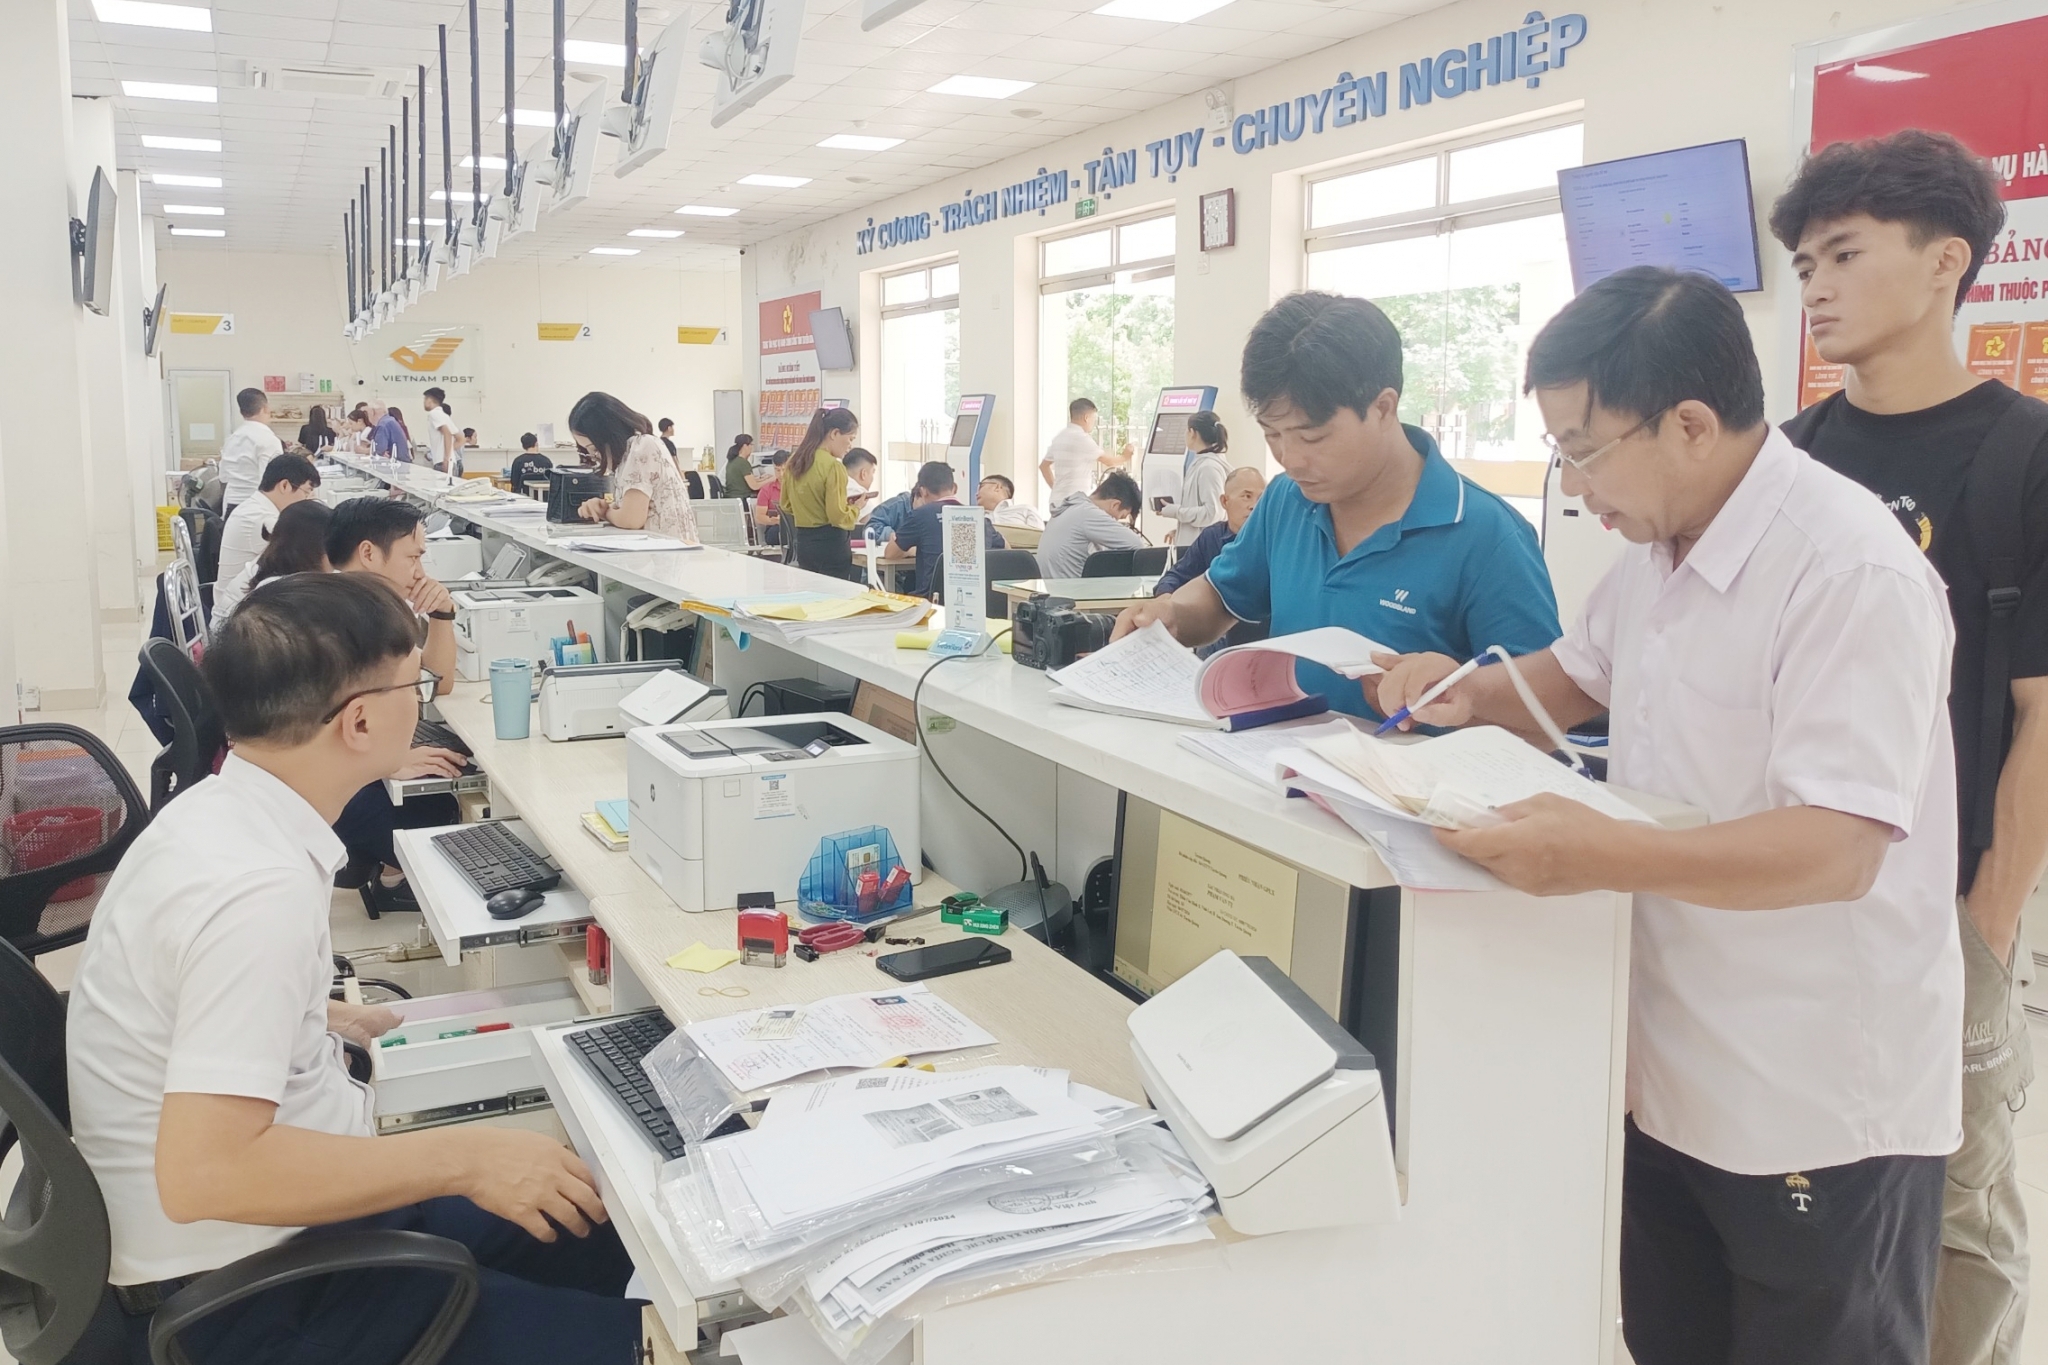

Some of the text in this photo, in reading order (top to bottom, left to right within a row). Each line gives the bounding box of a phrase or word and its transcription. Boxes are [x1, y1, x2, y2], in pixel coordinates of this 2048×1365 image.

[856, 217, 876, 255] KỶ
[878, 212, 930, 249] CƯƠNG
[940, 189, 997, 233] TRÁCH
[1001, 167, 1068, 217] NHIỆM
[1083, 147, 1137, 199] TẬN
[1145, 127, 1205, 183] TỤY
[1231, 71, 1388, 155] CHUYÊN
[1399, 10, 1588, 110] NGHIỆP
[1984, 229, 2048, 265] BẢN
[1999, 277, 2038, 304] THUỘC
[223, 320, 232, 331] 3
[582, 326, 591, 337] 2
[721, 331, 726, 341] 1
[441, 375, 475, 383] POST
[1077, 1199, 1097, 1207] Anh
[902, 1262, 927, 1277] VIỆT
[876, 1275, 901, 1292] NAM
